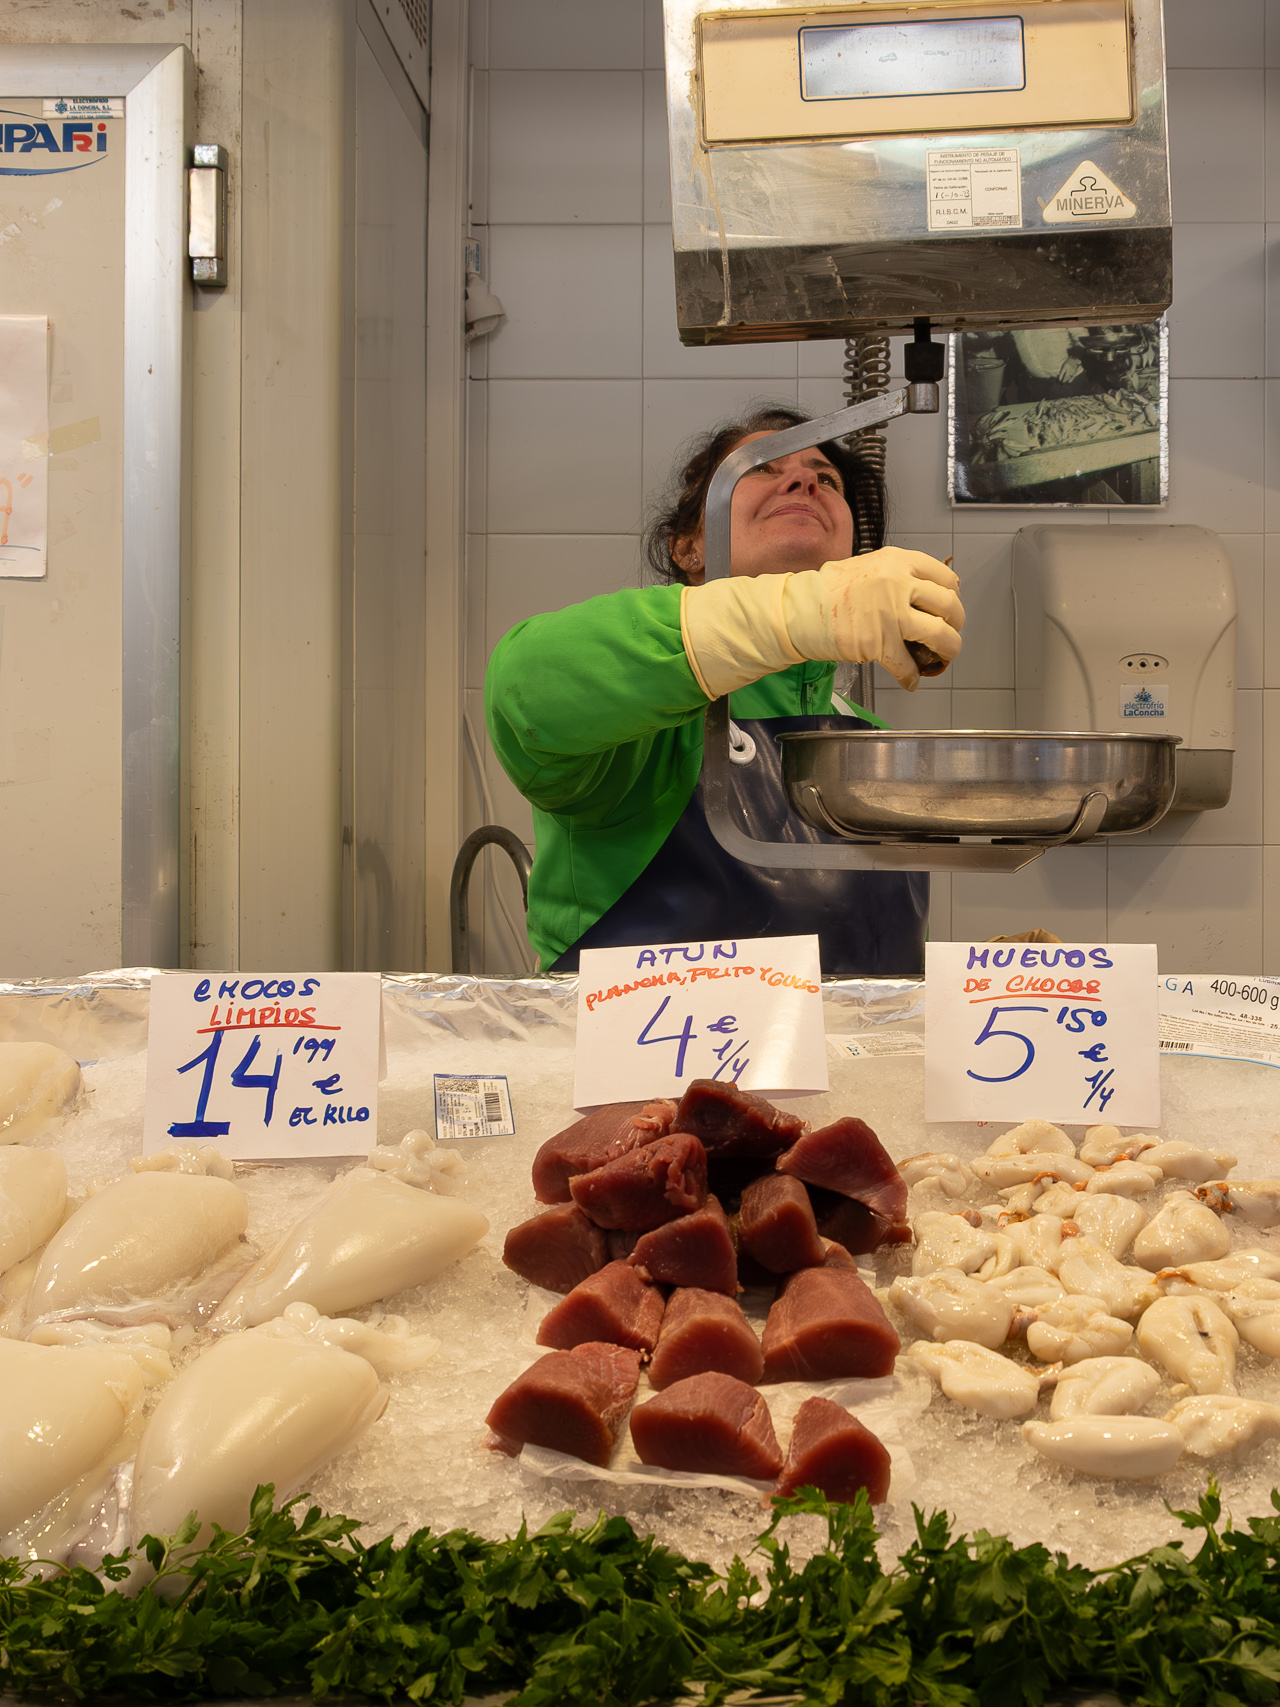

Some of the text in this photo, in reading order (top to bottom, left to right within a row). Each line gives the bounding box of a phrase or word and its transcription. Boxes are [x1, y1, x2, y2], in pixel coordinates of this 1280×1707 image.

[1056, 195, 1124, 211] MINERVA
[637, 941, 738, 969] ATUN
[966, 946, 1114, 969] HUEVOS
[963, 977, 992, 993] DE
[1210, 979, 1268, 1004] 400-600
[1270, 995, 1280, 1010] g
[637, 996, 697, 1077] 4
[323, 1103, 370, 1126] KILO
